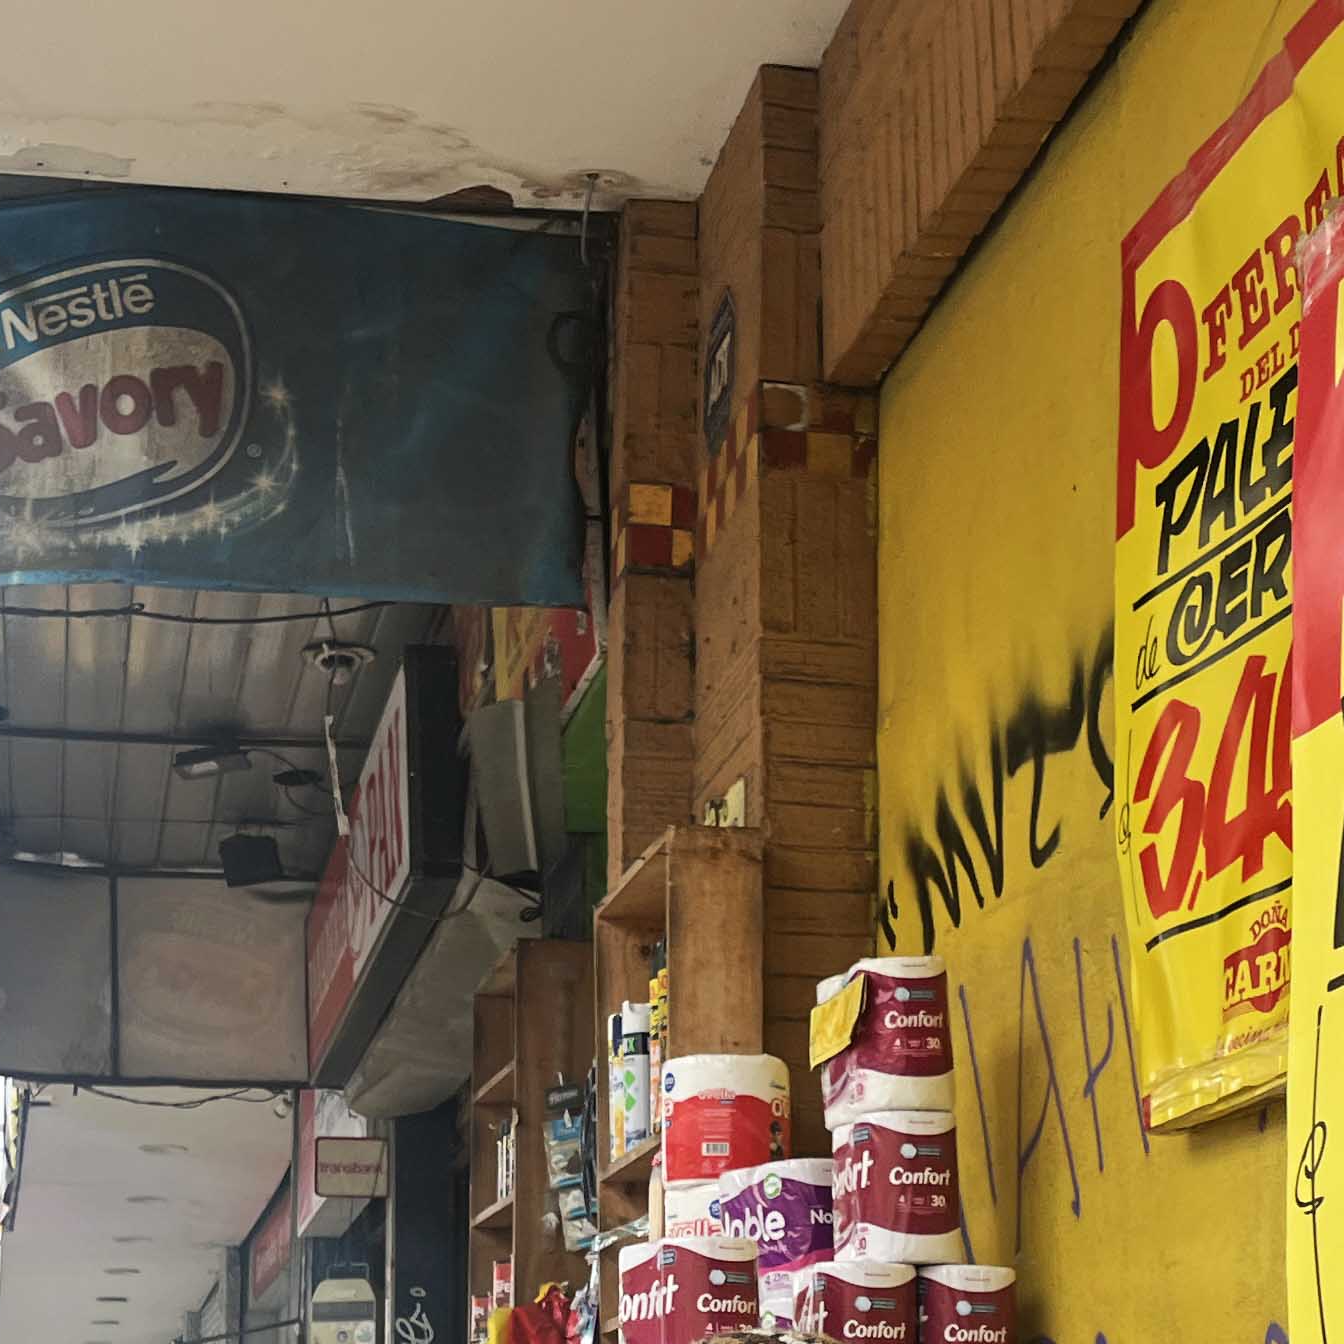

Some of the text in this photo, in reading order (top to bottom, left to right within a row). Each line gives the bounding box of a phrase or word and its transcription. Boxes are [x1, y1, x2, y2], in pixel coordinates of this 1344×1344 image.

[0, 270, 156, 353] Nestlé
[1239, 340, 1285, 403] DEL
[884, 1010, 944, 1029] Confort
[925, 1036, 942, 1050] 30
[889, 1166, 951, 1186] Confort
[930, 1195, 946, 1207] 30
[843, 1319, 906, 1340] Confort
[943, 1324, 1008, 1344] Confort
